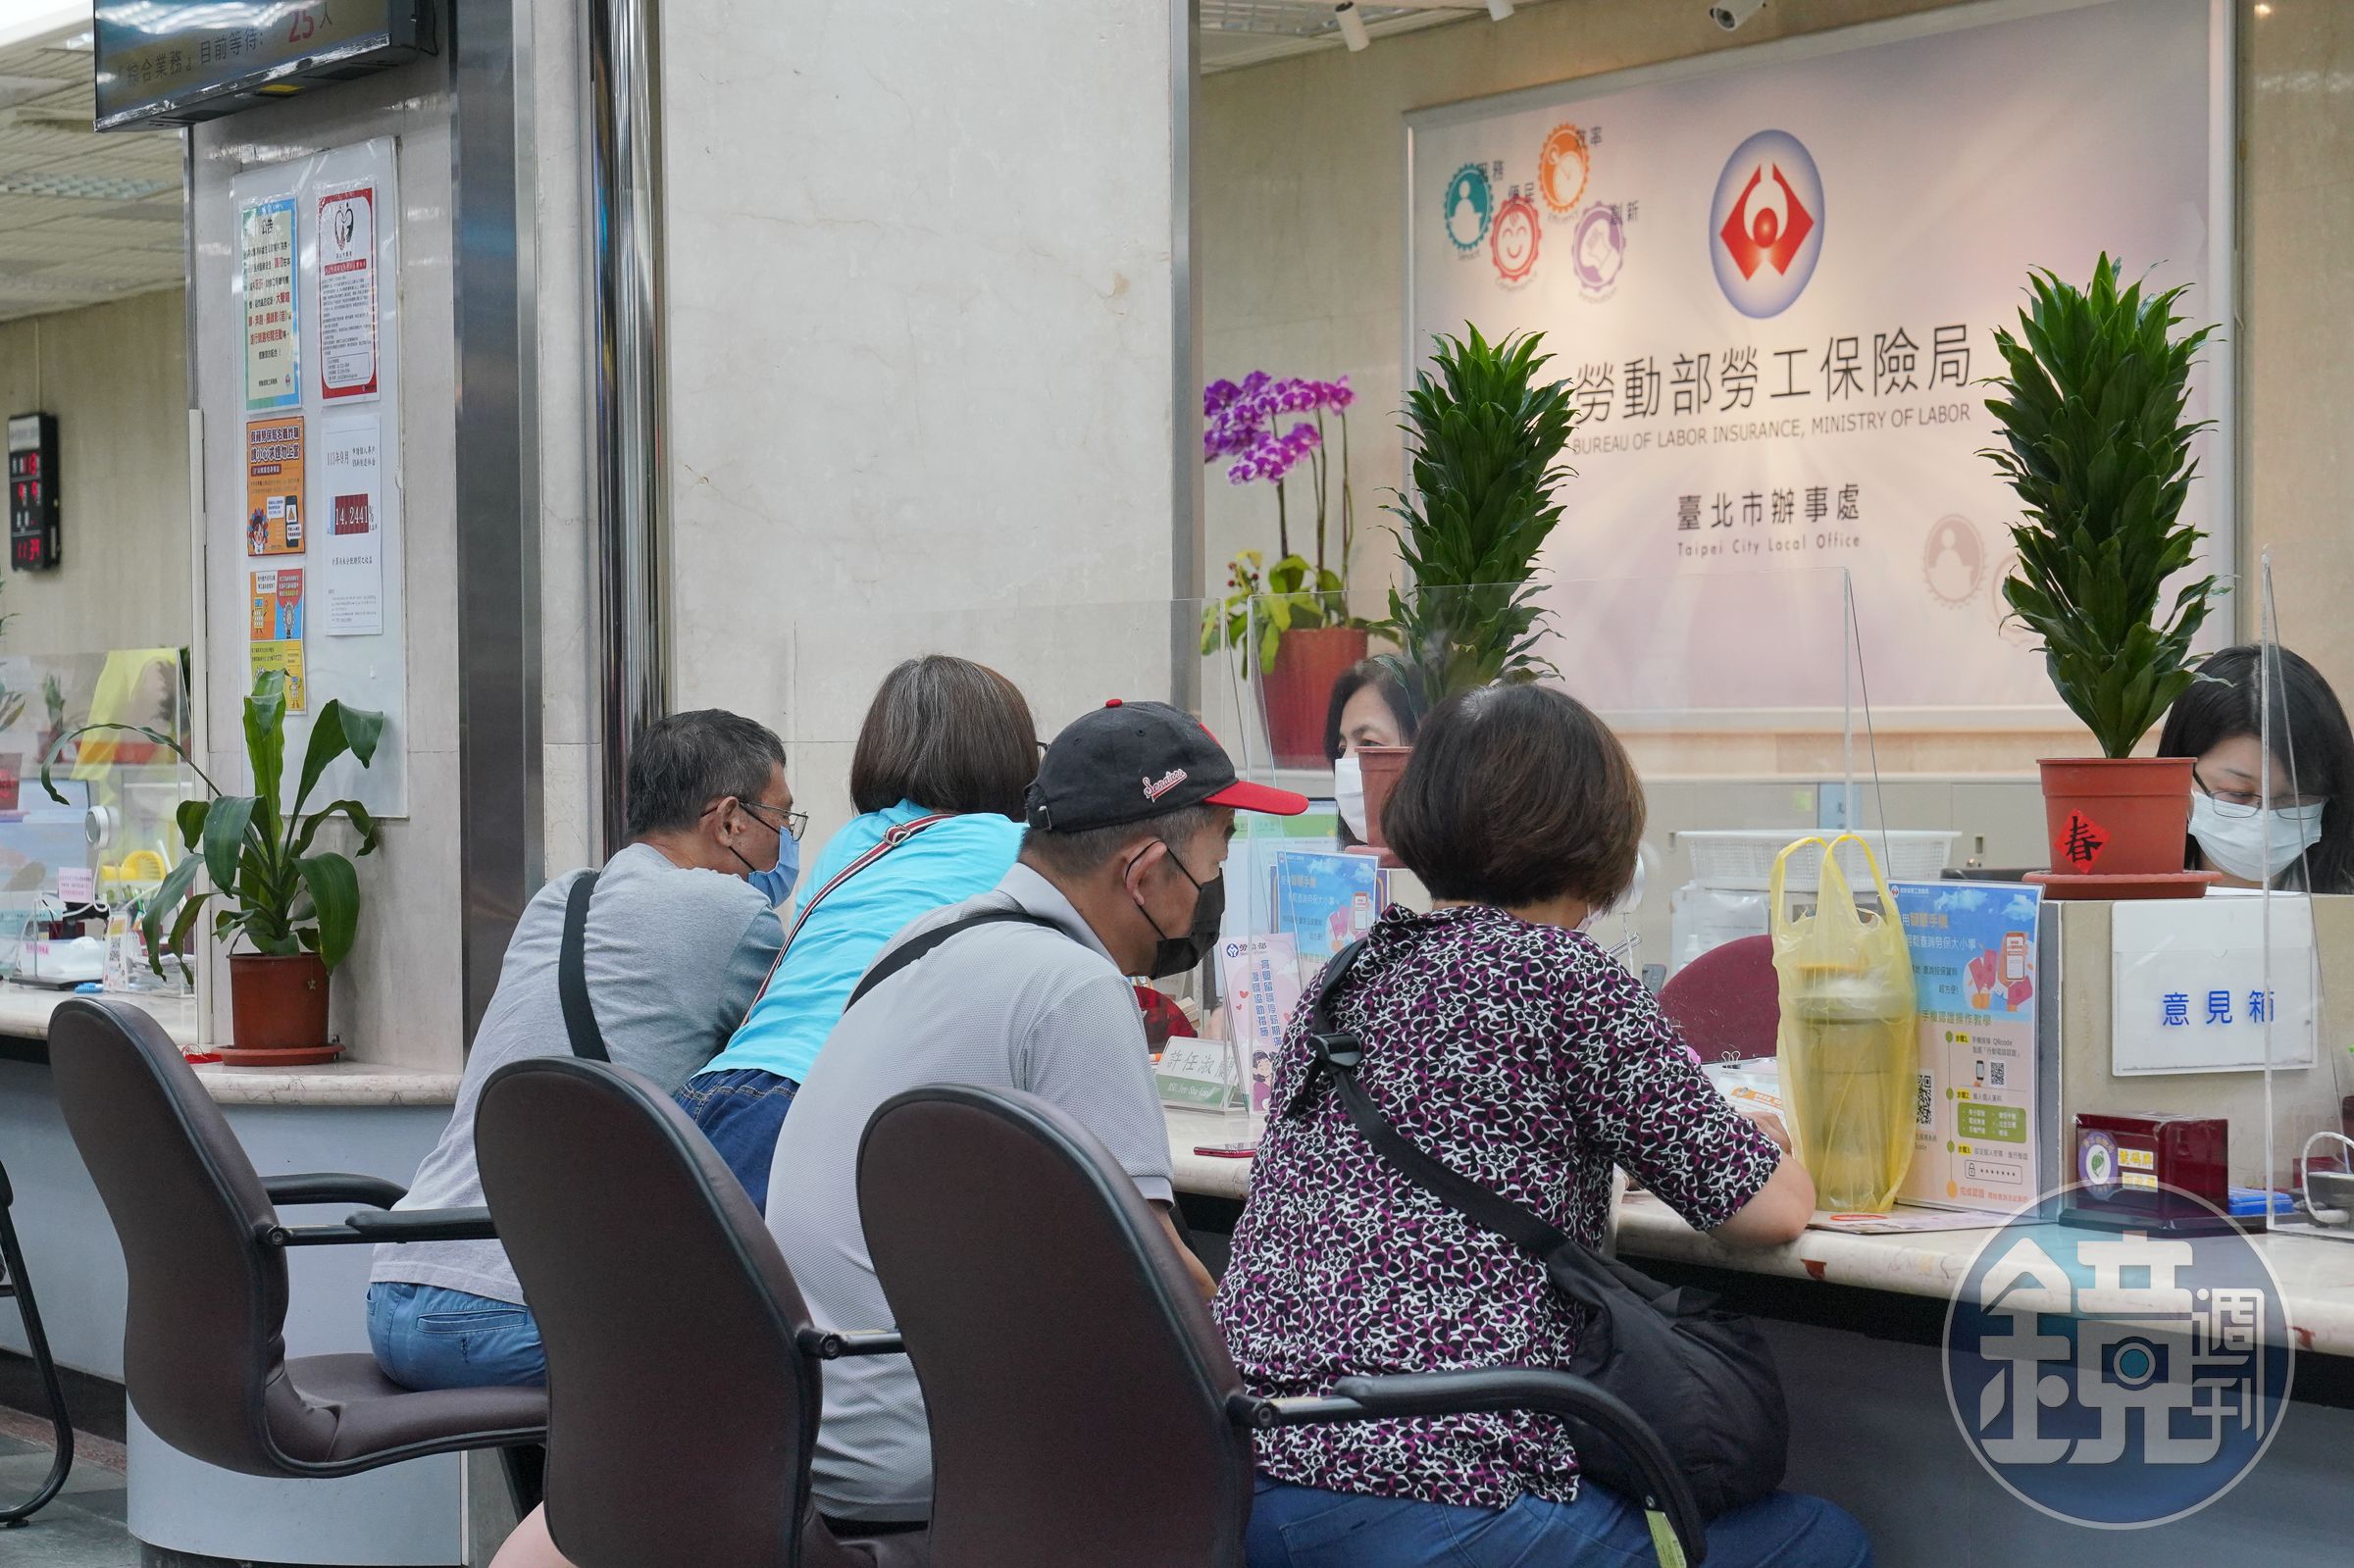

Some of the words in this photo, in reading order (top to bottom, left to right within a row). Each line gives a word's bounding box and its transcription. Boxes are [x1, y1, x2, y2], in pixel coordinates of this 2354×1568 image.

[288, 9, 315, 43] 25
[1574, 324, 1970, 425] 勞動部勞工保險局
[1572, 431, 1630, 456] BUREAU
[1633, 431, 1653, 450] OF
[1658, 428, 1708, 448] LABOR
[1713, 419, 1806, 444] INSURANCE,
[1812, 411, 1885, 434] MINISTRY
[1891, 408, 1915, 429] OF
[1919, 403, 1970, 425] LABOR
[335, 506, 369, 526] 14.2441
[1677, 483, 1860, 531] 臺北市辦事處
[1677, 541, 1723, 558] Taipei
[1732, 539, 1760, 555] City
[1767, 534, 1807, 552] Local
[1817, 531, 1861, 549] Office
[2065, 816, 2104, 864] 春
[2162, 988, 2276, 1028] 意見箱
